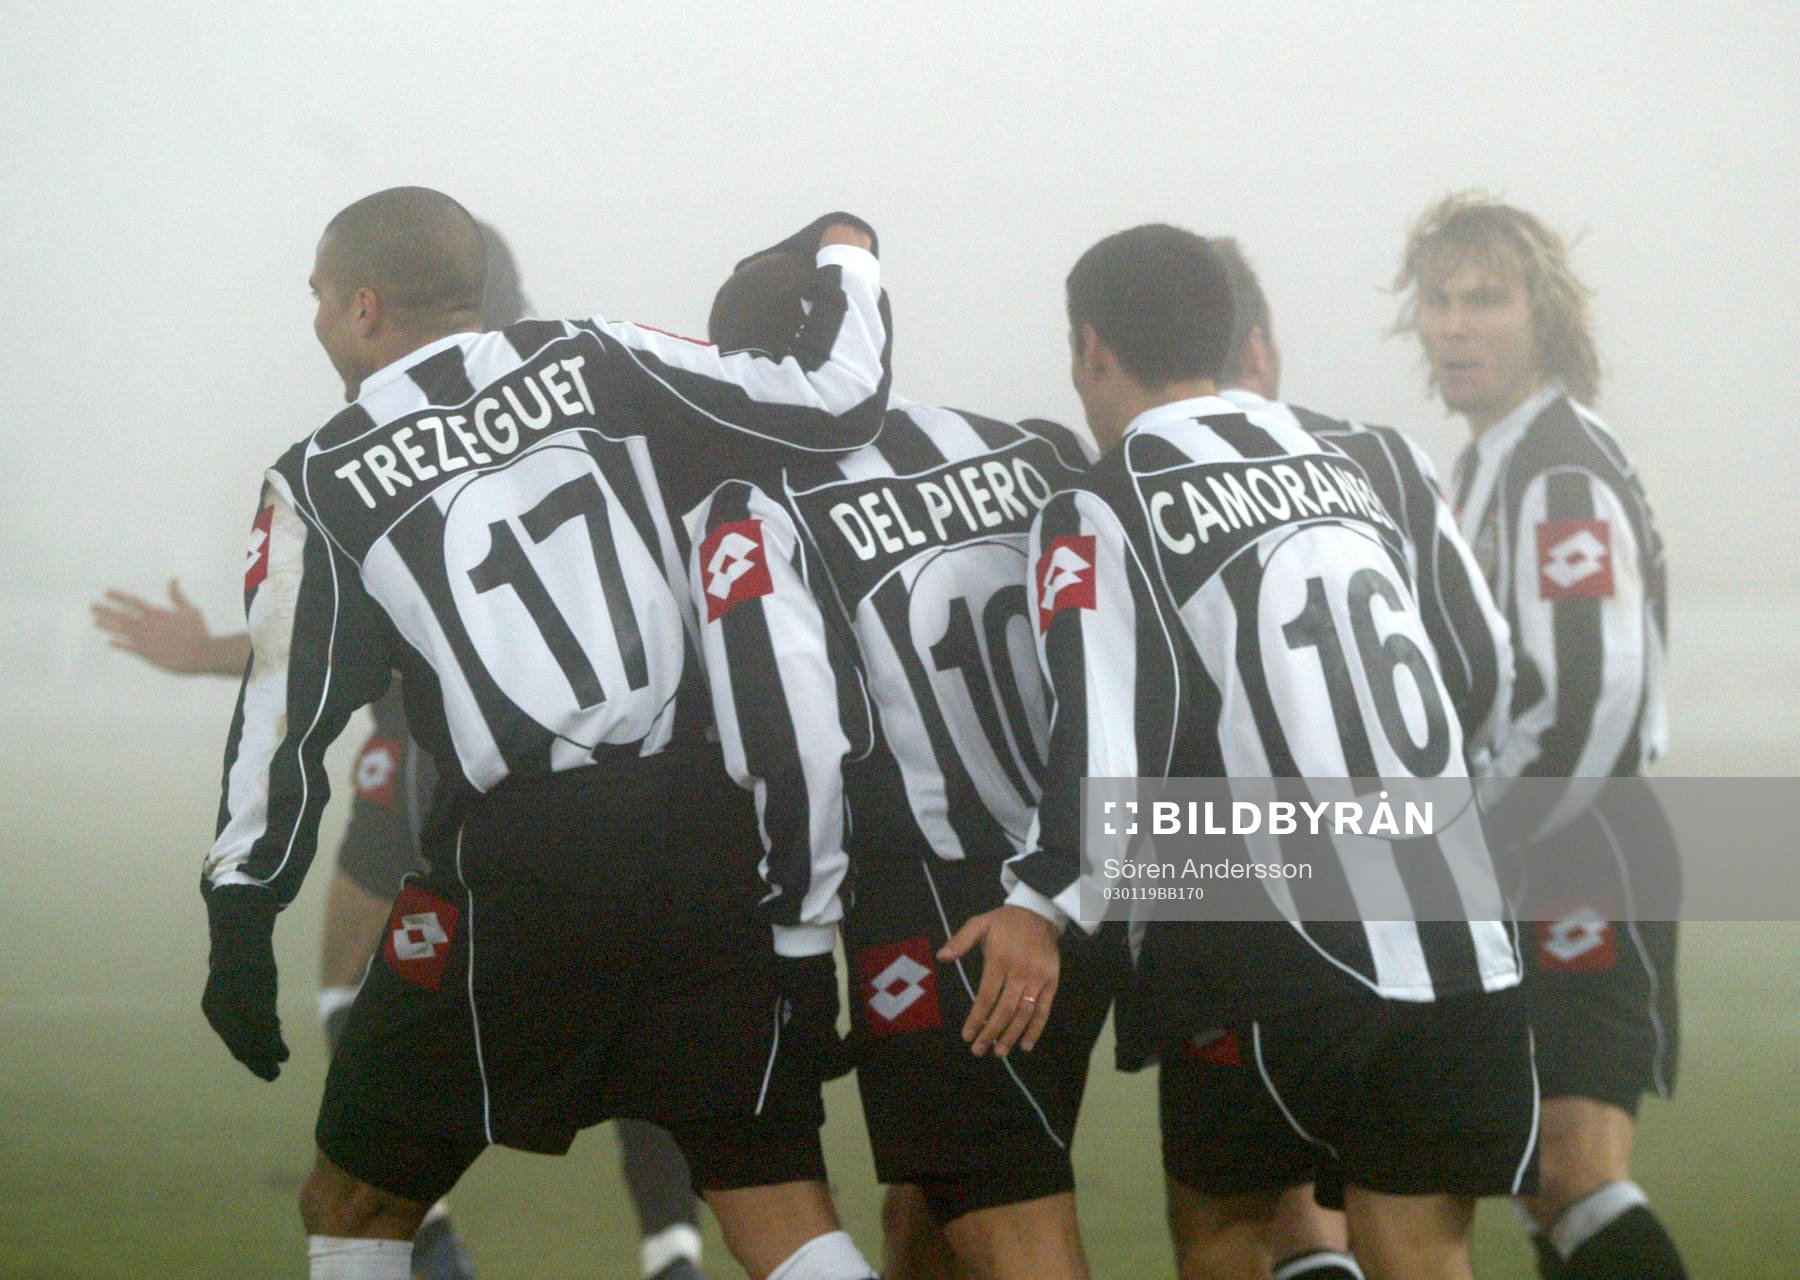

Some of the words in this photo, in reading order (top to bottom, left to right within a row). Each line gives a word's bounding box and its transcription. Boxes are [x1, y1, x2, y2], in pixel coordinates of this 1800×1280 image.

[334, 355, 596, 509] TREZEGUET
[829, 487, 927, 561] DEL
[917, 457, 1053, 542] PIERO
[466, 471, 650, 711] 17
[1281, 567, 1451, 798] 16
